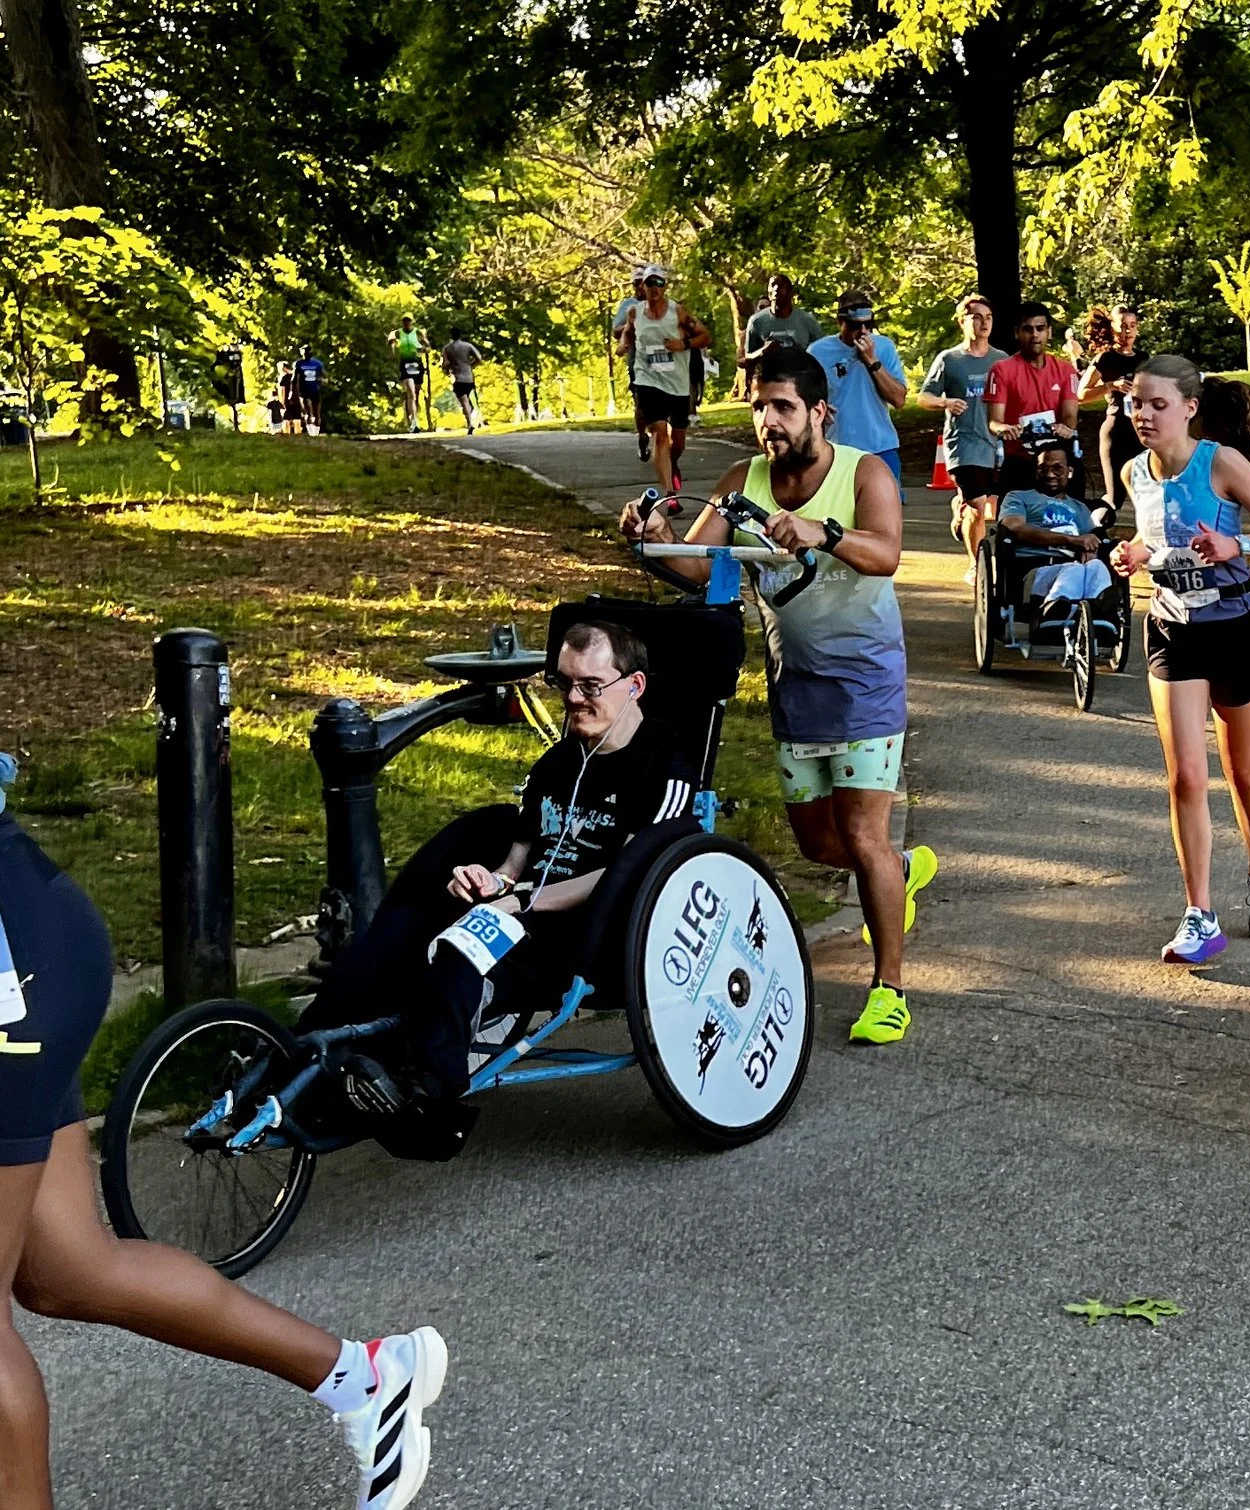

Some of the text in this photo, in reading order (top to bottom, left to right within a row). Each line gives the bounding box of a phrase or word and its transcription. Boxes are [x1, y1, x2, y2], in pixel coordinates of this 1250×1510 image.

[815, 569, 848, 583] EASE
[674, 880, 721, 958] LFG
[685, 900, 728, 1002] LIVE FOREVER GOLF
[744, 1012, 785, 1089] LFG
